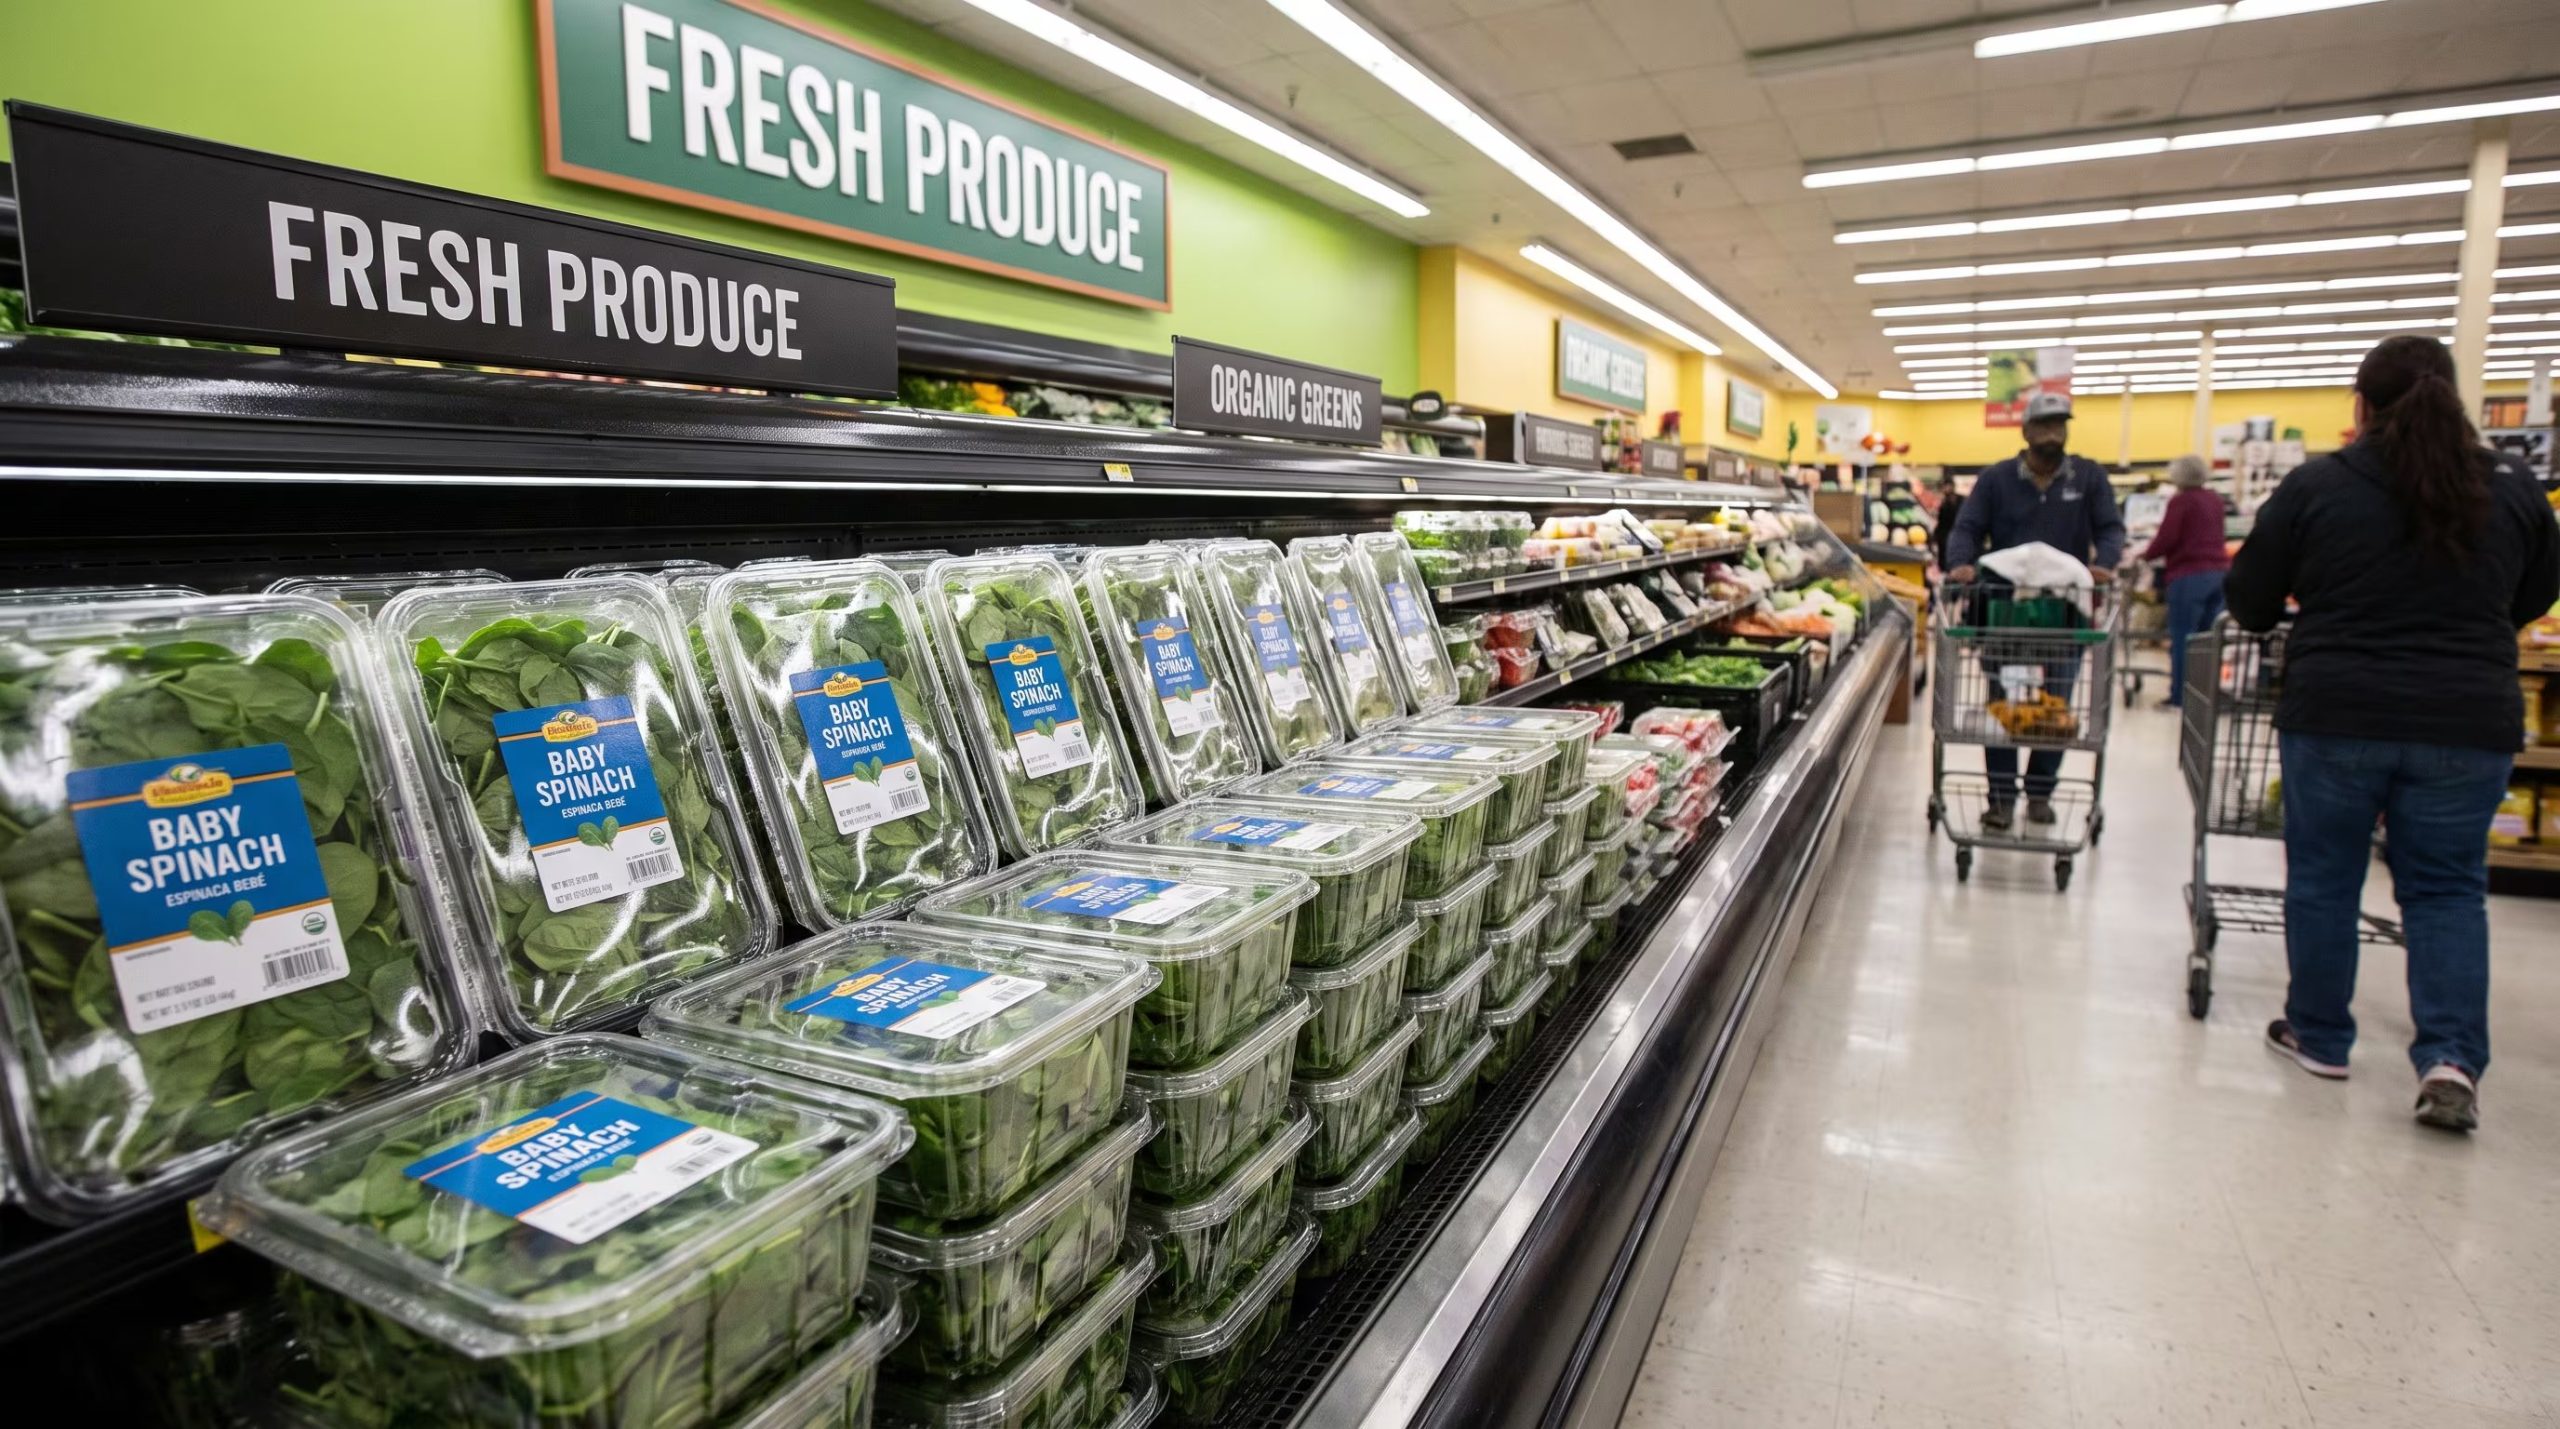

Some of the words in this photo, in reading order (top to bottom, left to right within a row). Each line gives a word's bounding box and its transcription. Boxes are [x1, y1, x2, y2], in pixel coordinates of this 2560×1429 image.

[622, 3, 885, 203] FRESH
[904, 103, 1144, 272] PRODUCE
[268, 200, 523, 328] FRESH
[547, 249, 803, 361] PRODUCE
[1211, 364, 1296, 423] ORGANIC
[1301, 381, 1362, 431] GREENS
[1155, 656, 1195, 677] SPINACH
[1157, 643, 1181, 660] BABY
[1014, 666, 1045, 688] BABY
[829, 698, 871, 725] BABY
[1010, 683, 1062, 709] SPINACH
[822, 716, 893, 749] SPINACH
[547, 743, 607, 776] BABY
[536, 765, 636, 807] SPINACH
[562, 803, 604, 819] ESPINACA
[605, 796, 627, 810] BEBÉ
[149, 805, 242, 851] BABY
[126, 834, 287, 893] SPINACH
[166, 884, 231, 907] ESPINACA
[234, 872, 267, 893] BEBÉ
[852, 977, 909, 1003] BABY
[857, 974, 952, 1015] SPINACH
[496, 1119, 641, 1190] SPINACH
[497, 1122, 586, 1168] BABY
